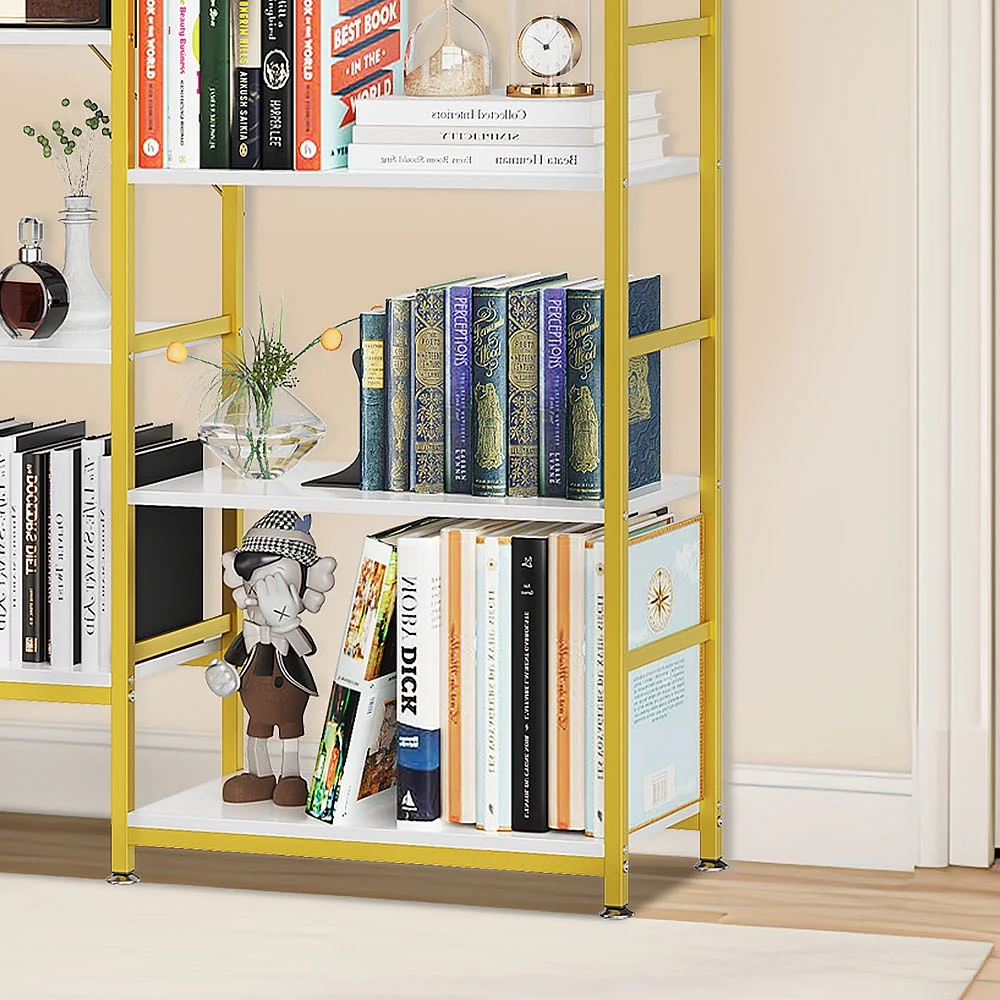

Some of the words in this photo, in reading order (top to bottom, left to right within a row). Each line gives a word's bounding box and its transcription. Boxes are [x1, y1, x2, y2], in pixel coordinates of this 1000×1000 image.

[178, 6, 186, 36] Beauty
[334, 19, 362, 50] BEST
[364, 1, 398, 38] BOOK
[146, 39, 156, 79] WORLD
[239, 38, 248, 64] HILLS
[304, 39, 312, 80] WORLD
[351, 60, 361, 76] IN
[364, 50, 380, 69] THE
[240, 71, 248, 107] ANKUSH
[240, 110, 248, 140] SAIKIA
[270, 100, 282, 130] HARPER
[270, 131, 282, 148] LEE
[454, 298, 467, 366] PERCEPTIONS
[549, 300, 562, 369] PERCEPTIONS
[401, 576, 418, 640] MOBY
[401, 646, 418, 715] DICK
